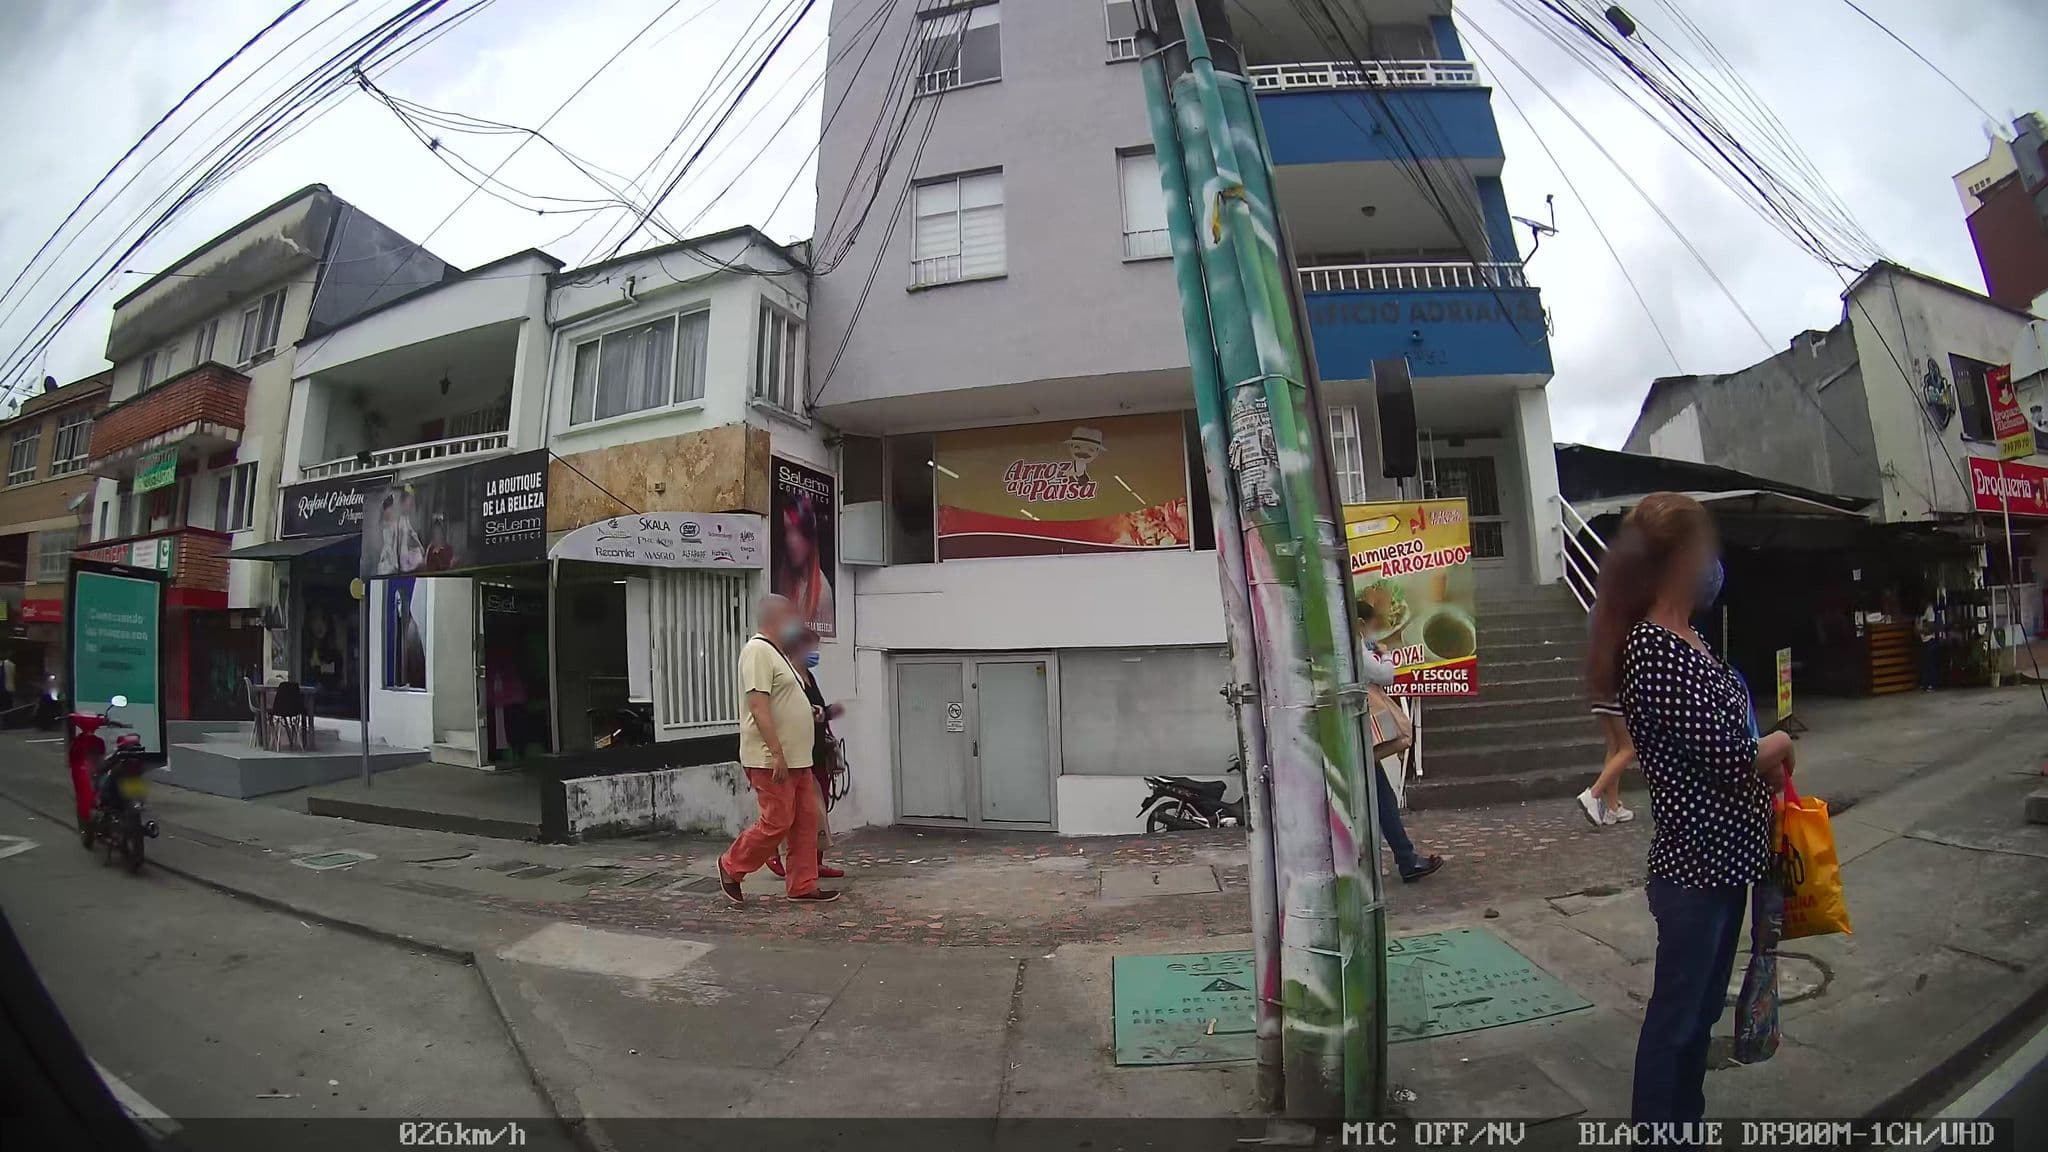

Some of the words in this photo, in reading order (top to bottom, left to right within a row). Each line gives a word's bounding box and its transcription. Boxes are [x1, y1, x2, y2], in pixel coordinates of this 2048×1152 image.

[1004, 459, 1072, 481] Arroz
[487, 480, 497, 497] LA
[499, 472, 542, 494] BOUTIQUE
[1030, 480, 1096, 501] Paisa
[299, 491, 328, 519] Rafael
[483, 501, 494, 517] DE
[495, 498, 506, 515] LA
[508, 492, 544, 513] BELLEZA
[639, 517, 671, 532] SKALA
[1381, 546, 1466, 578] ARROZUDO
[1404, 645, 1424, 665] YA!
[1412, 670, 1421, 681] Y
[1423, 669, 1468, 681] ESCOGE
[1410, 682, 1469, 693] PREFERIDO
